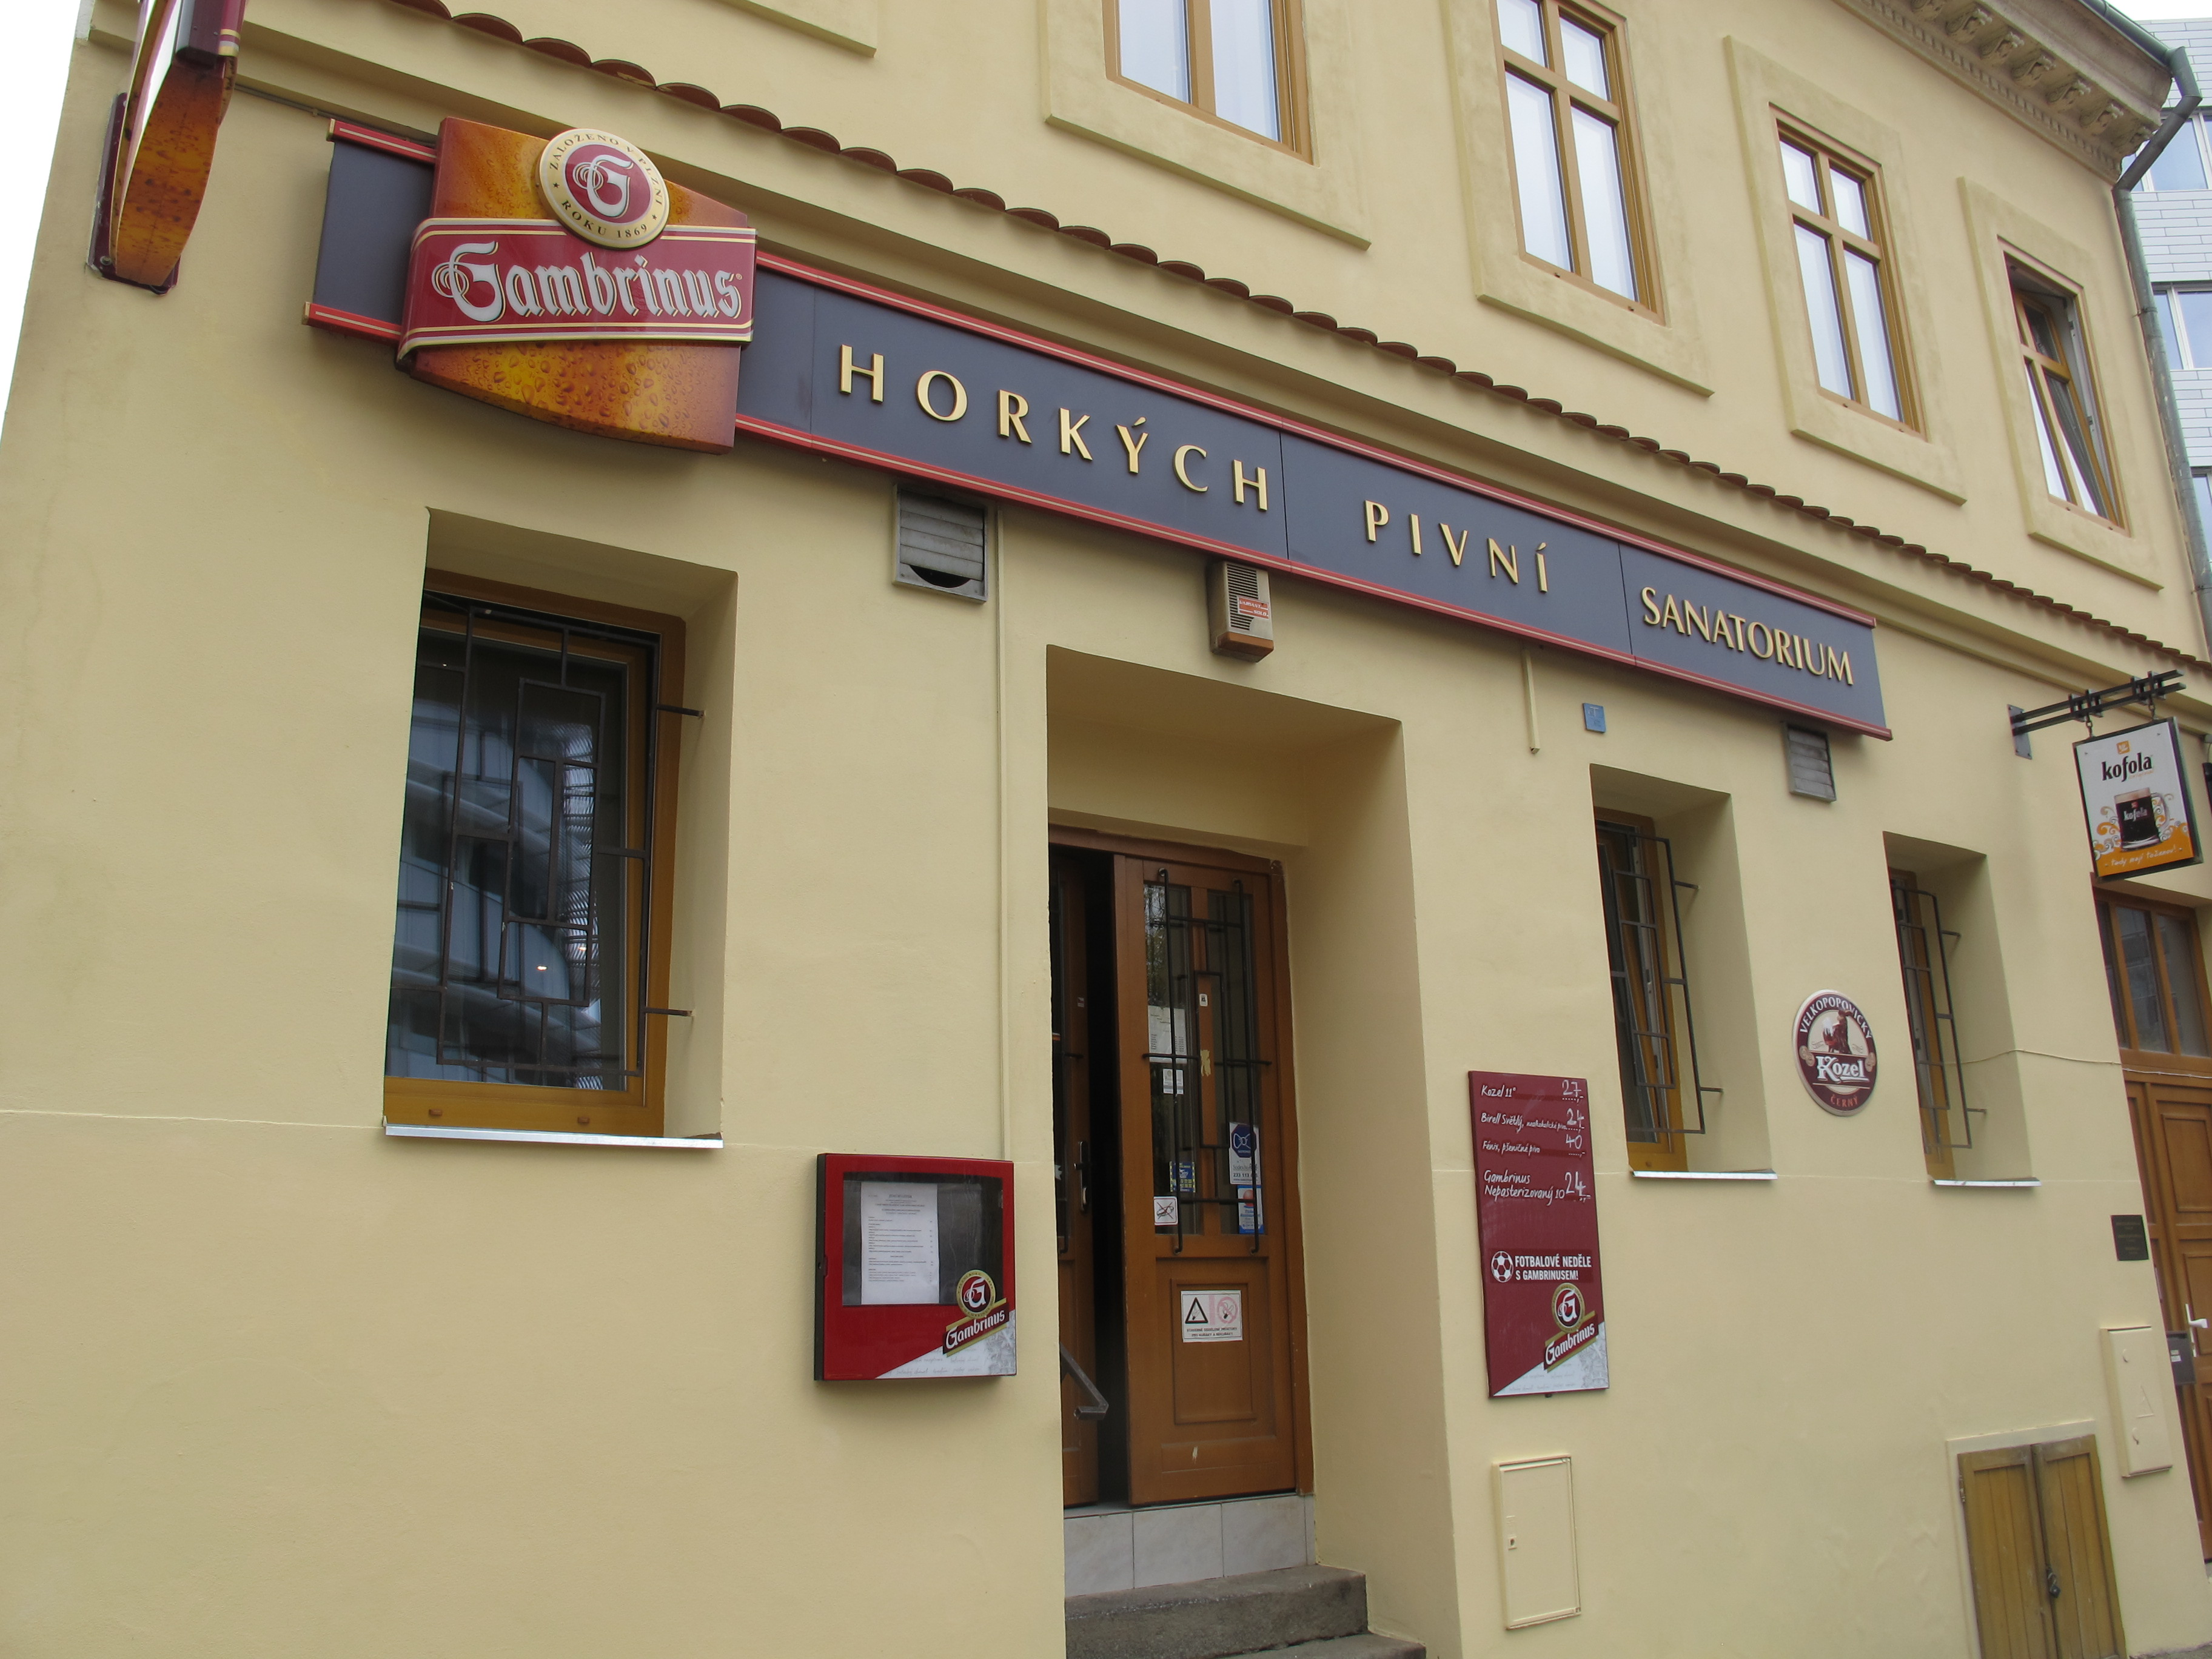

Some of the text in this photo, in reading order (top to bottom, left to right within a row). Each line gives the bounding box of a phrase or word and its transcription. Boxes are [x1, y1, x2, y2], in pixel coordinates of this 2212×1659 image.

[550, 133, 619, 170] ZALOŽENO
[561, 199, 648, 238] ROKU 1869
[431, 241, 742, 323] Gambrinus
[839, 344, 1854, 686] HORKÝCH PIVNÍ SANATORIUM
[2101, 752, 2153, 782] kofola
[2123, 807, 2148, 822] kofola
[1815, 1056, 1869, 1084] Kozel
[1481, 1085, 1503, 1097] Kozel
[1481, 1113, 1501, 1124] Birell
[1484, 1170, 1530, 1184] Gambrinus
[1484, 1185, 1553, 1206] Nepasterizovaný
[1555, 1189, 1565, 1199] 10
[1515, 1253, 1592, 1267] FOTBALOVÉ NEDĚLE
[1515, 1270, 1579, 1281] S GAMBRINUSEM!
[945, 1309, 1005, 1349] Gambrinus
[1546, 1323, 1595, 1365] Gambrinus
